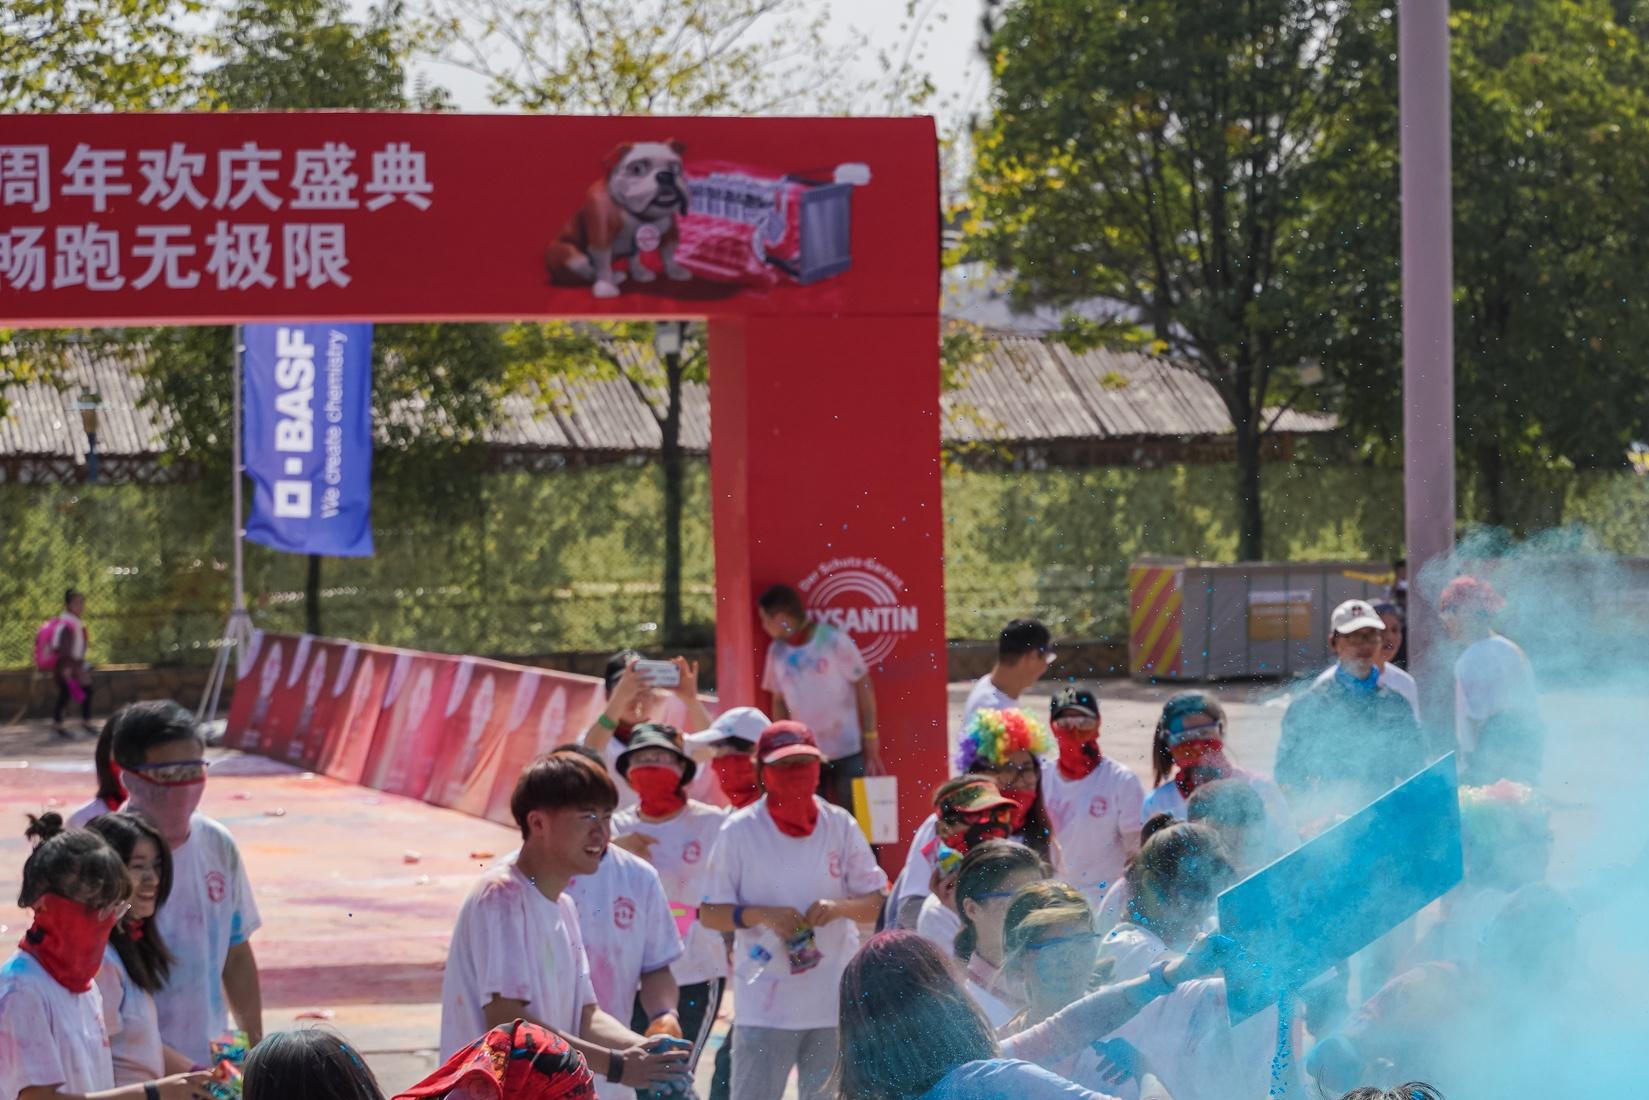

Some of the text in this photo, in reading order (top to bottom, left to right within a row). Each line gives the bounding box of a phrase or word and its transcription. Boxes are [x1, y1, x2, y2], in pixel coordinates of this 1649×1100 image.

[0, 142, 433, 213] 周年欢庆盛典
[0, 220, 352, 292] 畅跑无极限
[274, 327, 315, 452] BASF
[321, 329, 348, 519] We create chemistry
